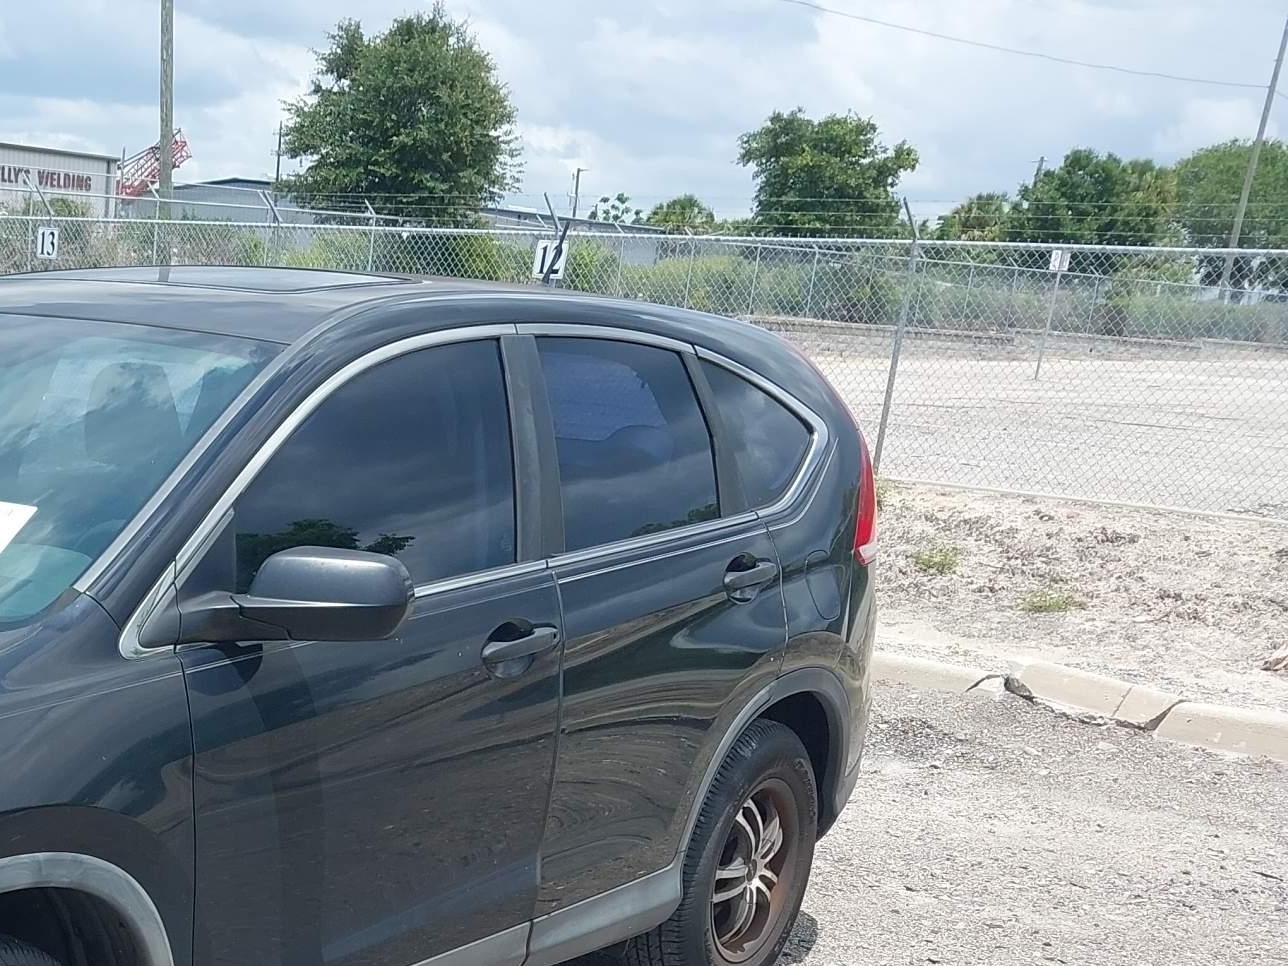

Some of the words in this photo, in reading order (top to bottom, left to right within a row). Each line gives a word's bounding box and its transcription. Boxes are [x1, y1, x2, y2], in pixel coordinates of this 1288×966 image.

[37, 169, 92, 191] WELDING
[40, 231, 55, 255] 13
[536, 245, 561, 274] 12
